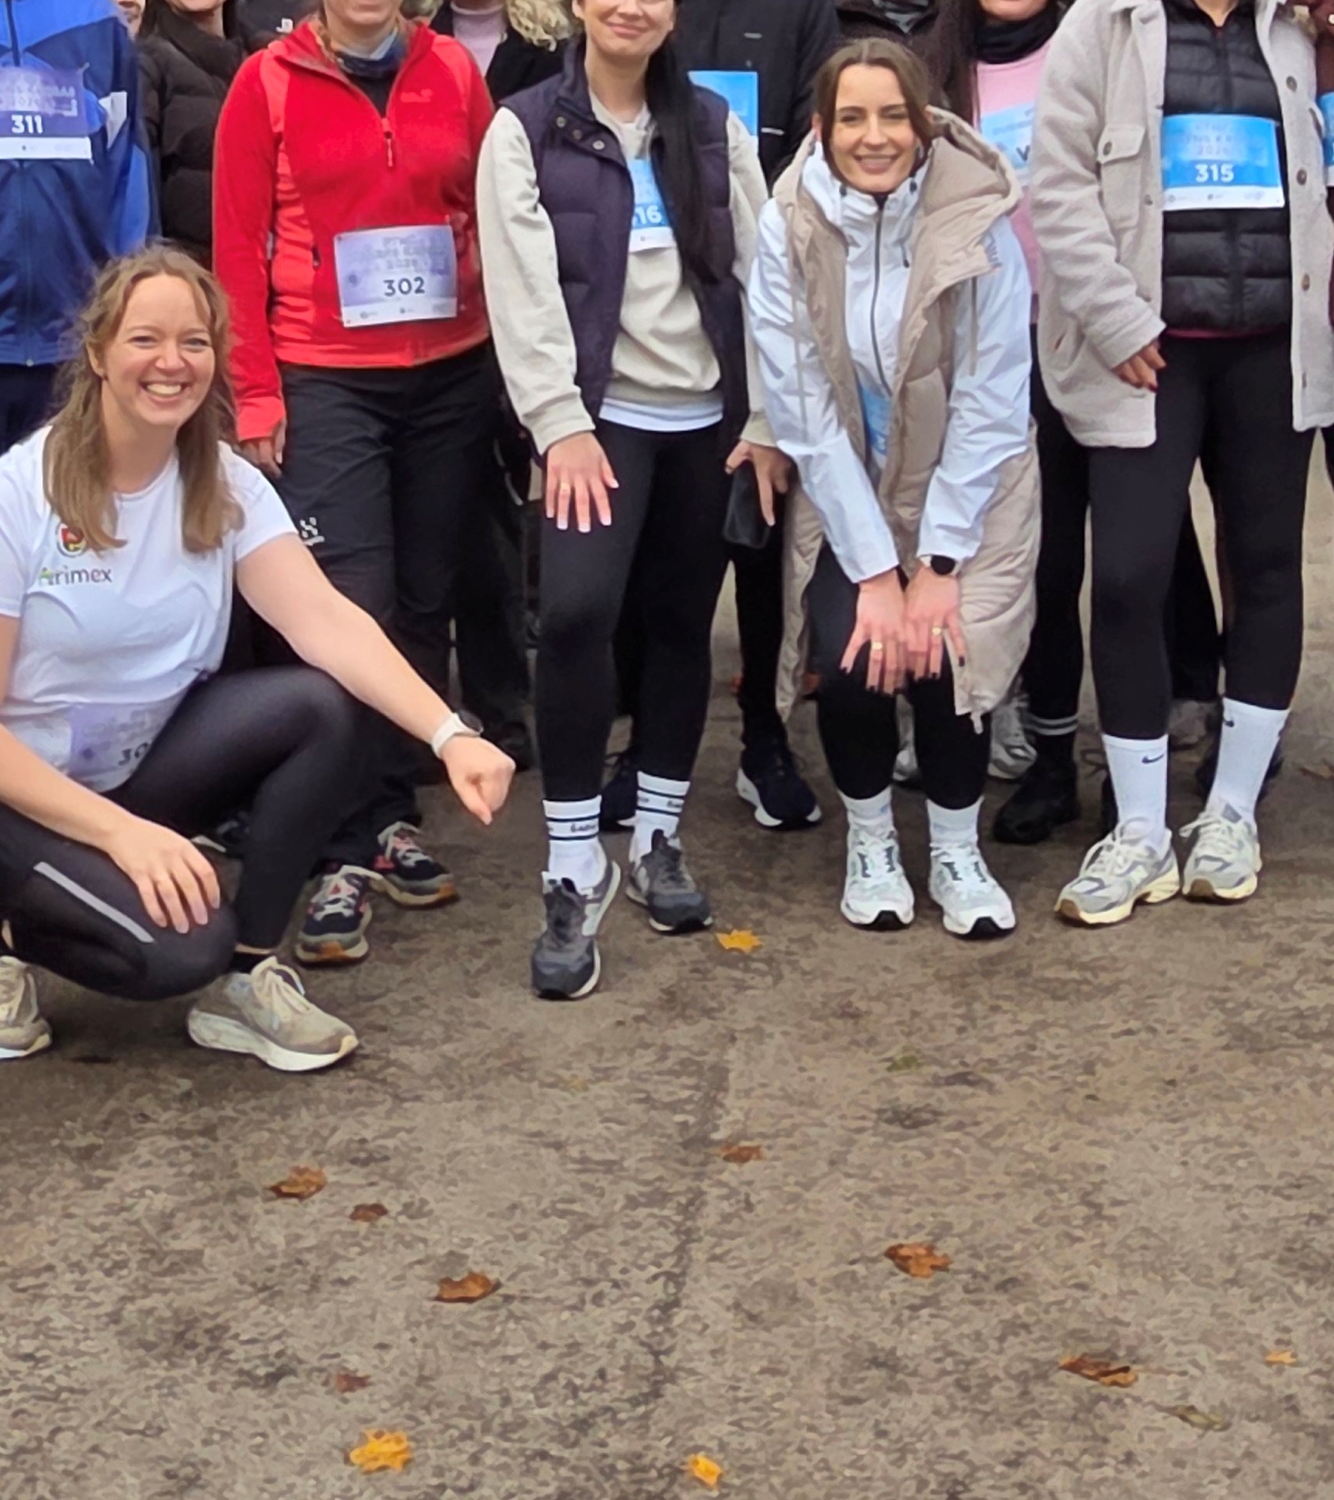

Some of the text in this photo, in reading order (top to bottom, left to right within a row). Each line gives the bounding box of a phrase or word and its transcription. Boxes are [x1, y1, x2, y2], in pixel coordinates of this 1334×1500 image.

[11, 114, 43, 134] 311
[1195, 164, 1234, 183] 315
[383, 276, 425, 297] 302
